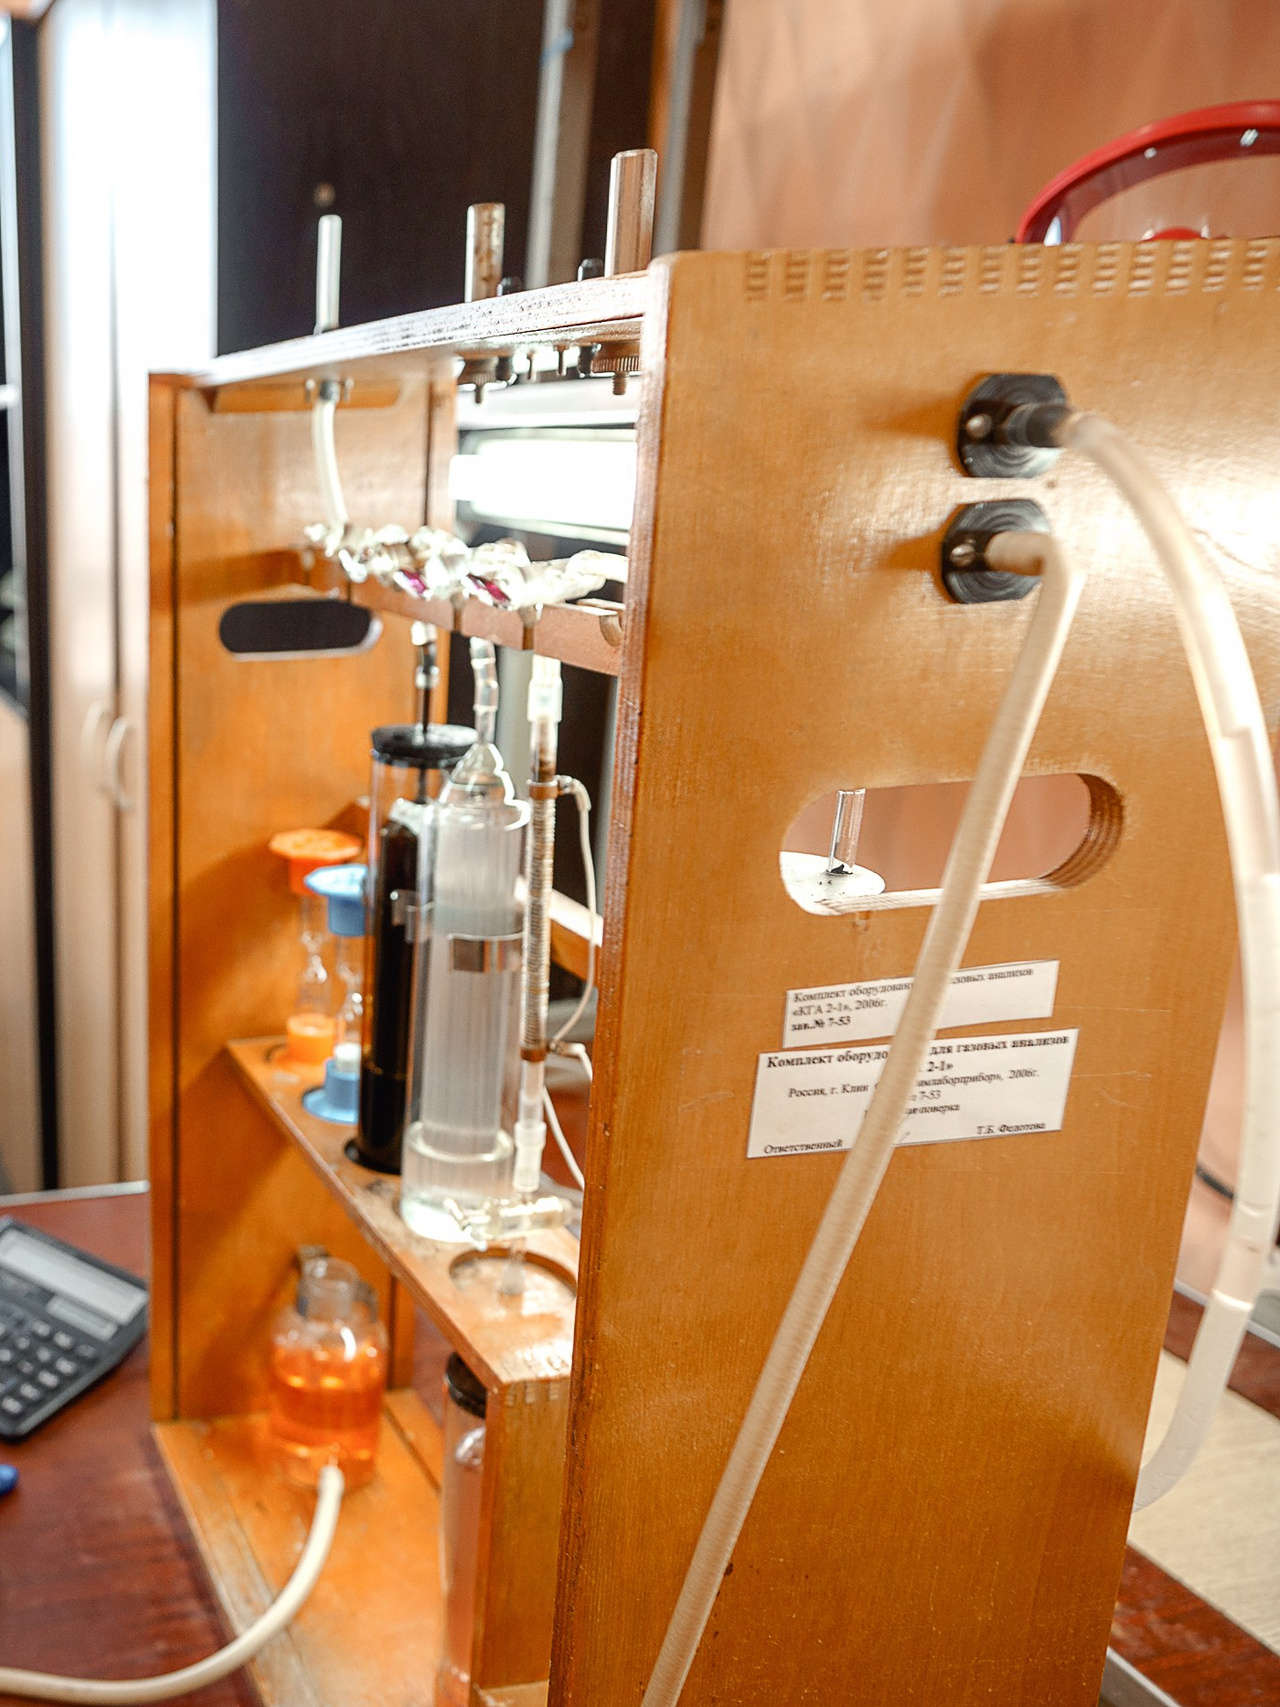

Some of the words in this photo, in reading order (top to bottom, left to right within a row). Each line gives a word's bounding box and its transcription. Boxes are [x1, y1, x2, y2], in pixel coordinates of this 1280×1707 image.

[794, 989, 847, 1002] Комплект
[849, 982, 914, 996] оборудован
[767, 1054, 833, 1068] Комплект
[929, 1046, 953, 1056] для
[956, 1041, 1008, 1053] газовых
[1012, 1036, 1070, 1048] анализов
[764, 1139, 843, 1154] Ответственный
